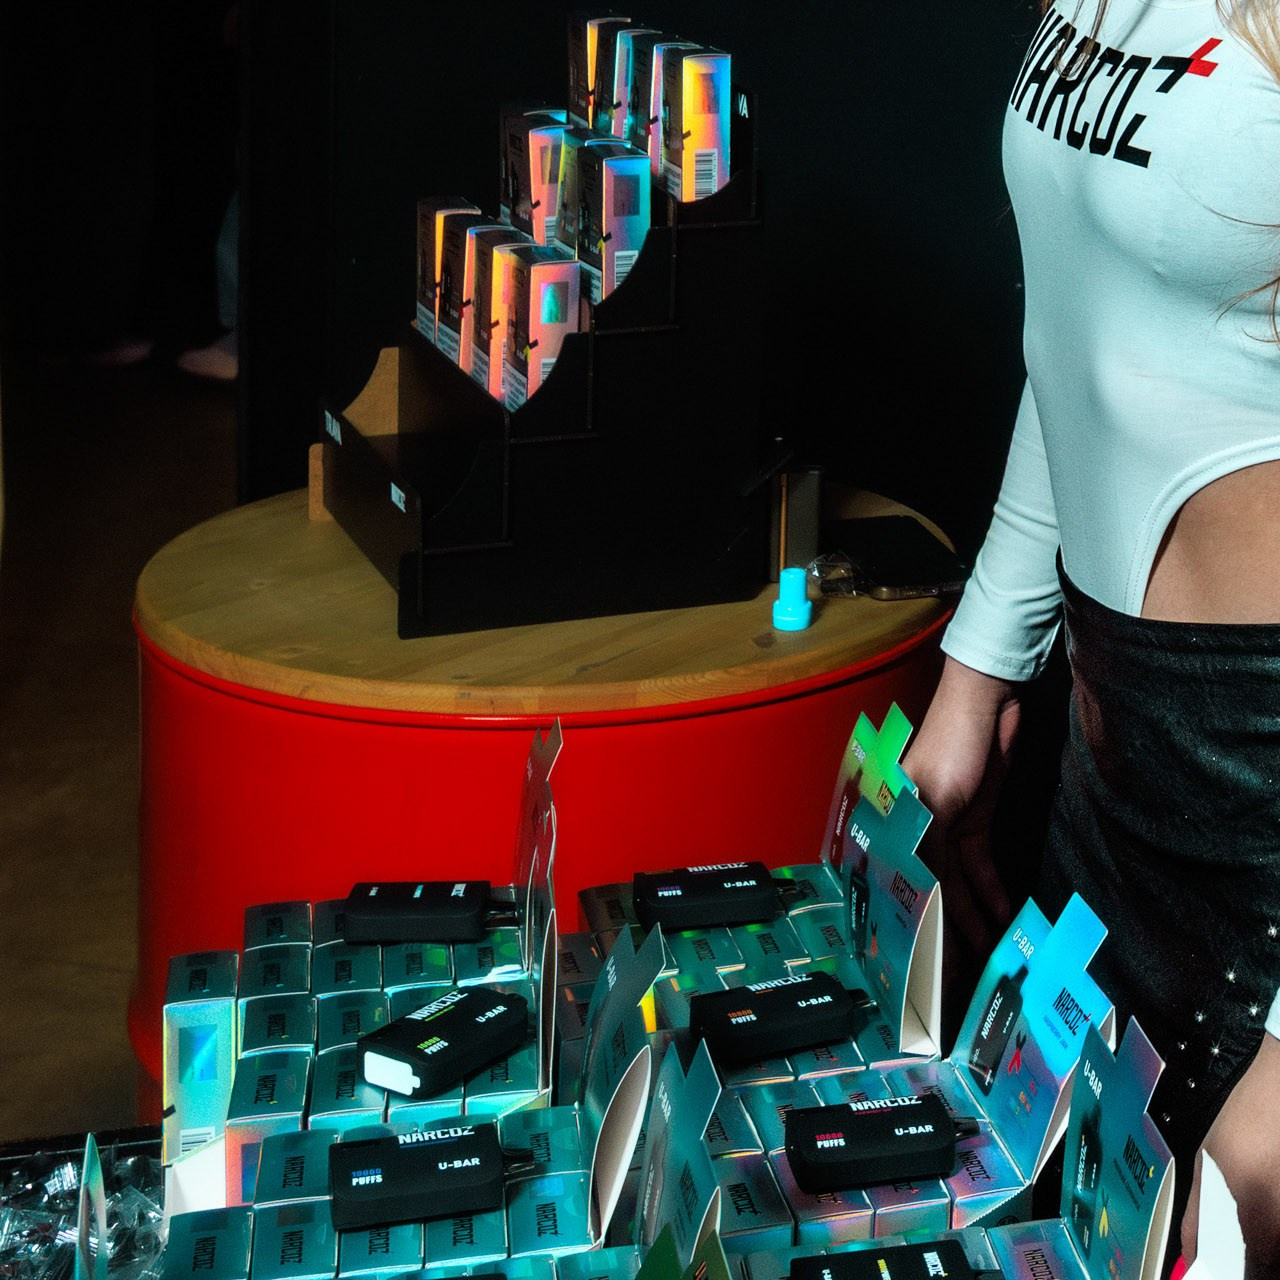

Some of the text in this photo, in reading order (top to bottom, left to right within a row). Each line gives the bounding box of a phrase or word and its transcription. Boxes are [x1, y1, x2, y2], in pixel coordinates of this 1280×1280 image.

[851, 823, 871, 853] U-BAR
[723, 880, 757, 889] U-BAR
[1011, 927, 1035, 960] U-BAR
[745, 974, 813, 992] NARCOZ
[404, 990, 469, 1020] NARCOZ
[475, 1005, 508, 1023] U-BAR
[797, 995, 833, 1008] U-BAR
[980, 991, 1003, 1040] NARCOZ
[1052, 986, 1089, 1036] NARCOZ
[1083, 1059, 1103, 1100] U-BAR
[849, 1095, 922, 1111] NARCOZ
[398, 1125, 476, 1144] NARCOZ
[816, 1138, 846, 1149] PUFFS
[894, 1124, 934, 1136] U-BAR
[283, 1155, 305, 1188] NARCOZ
[438, 1157, 481, 1170] U-BAR
[957, 1150, 990, 1182] NARCOZ
[352, 1175, 383, 1186] PUFFS
[728, 1182, 756, 1215] NARCOZ
[453, 1217, 474, 1246] ARCOZ
[537, 1202, 559, 1237] NARCOZ
[192, 1236, 217, 1271] NARCOZ
[280, 1230, 304, 1265] NARCOZ
[369, 1227, 390, 1255] ARCOZ
